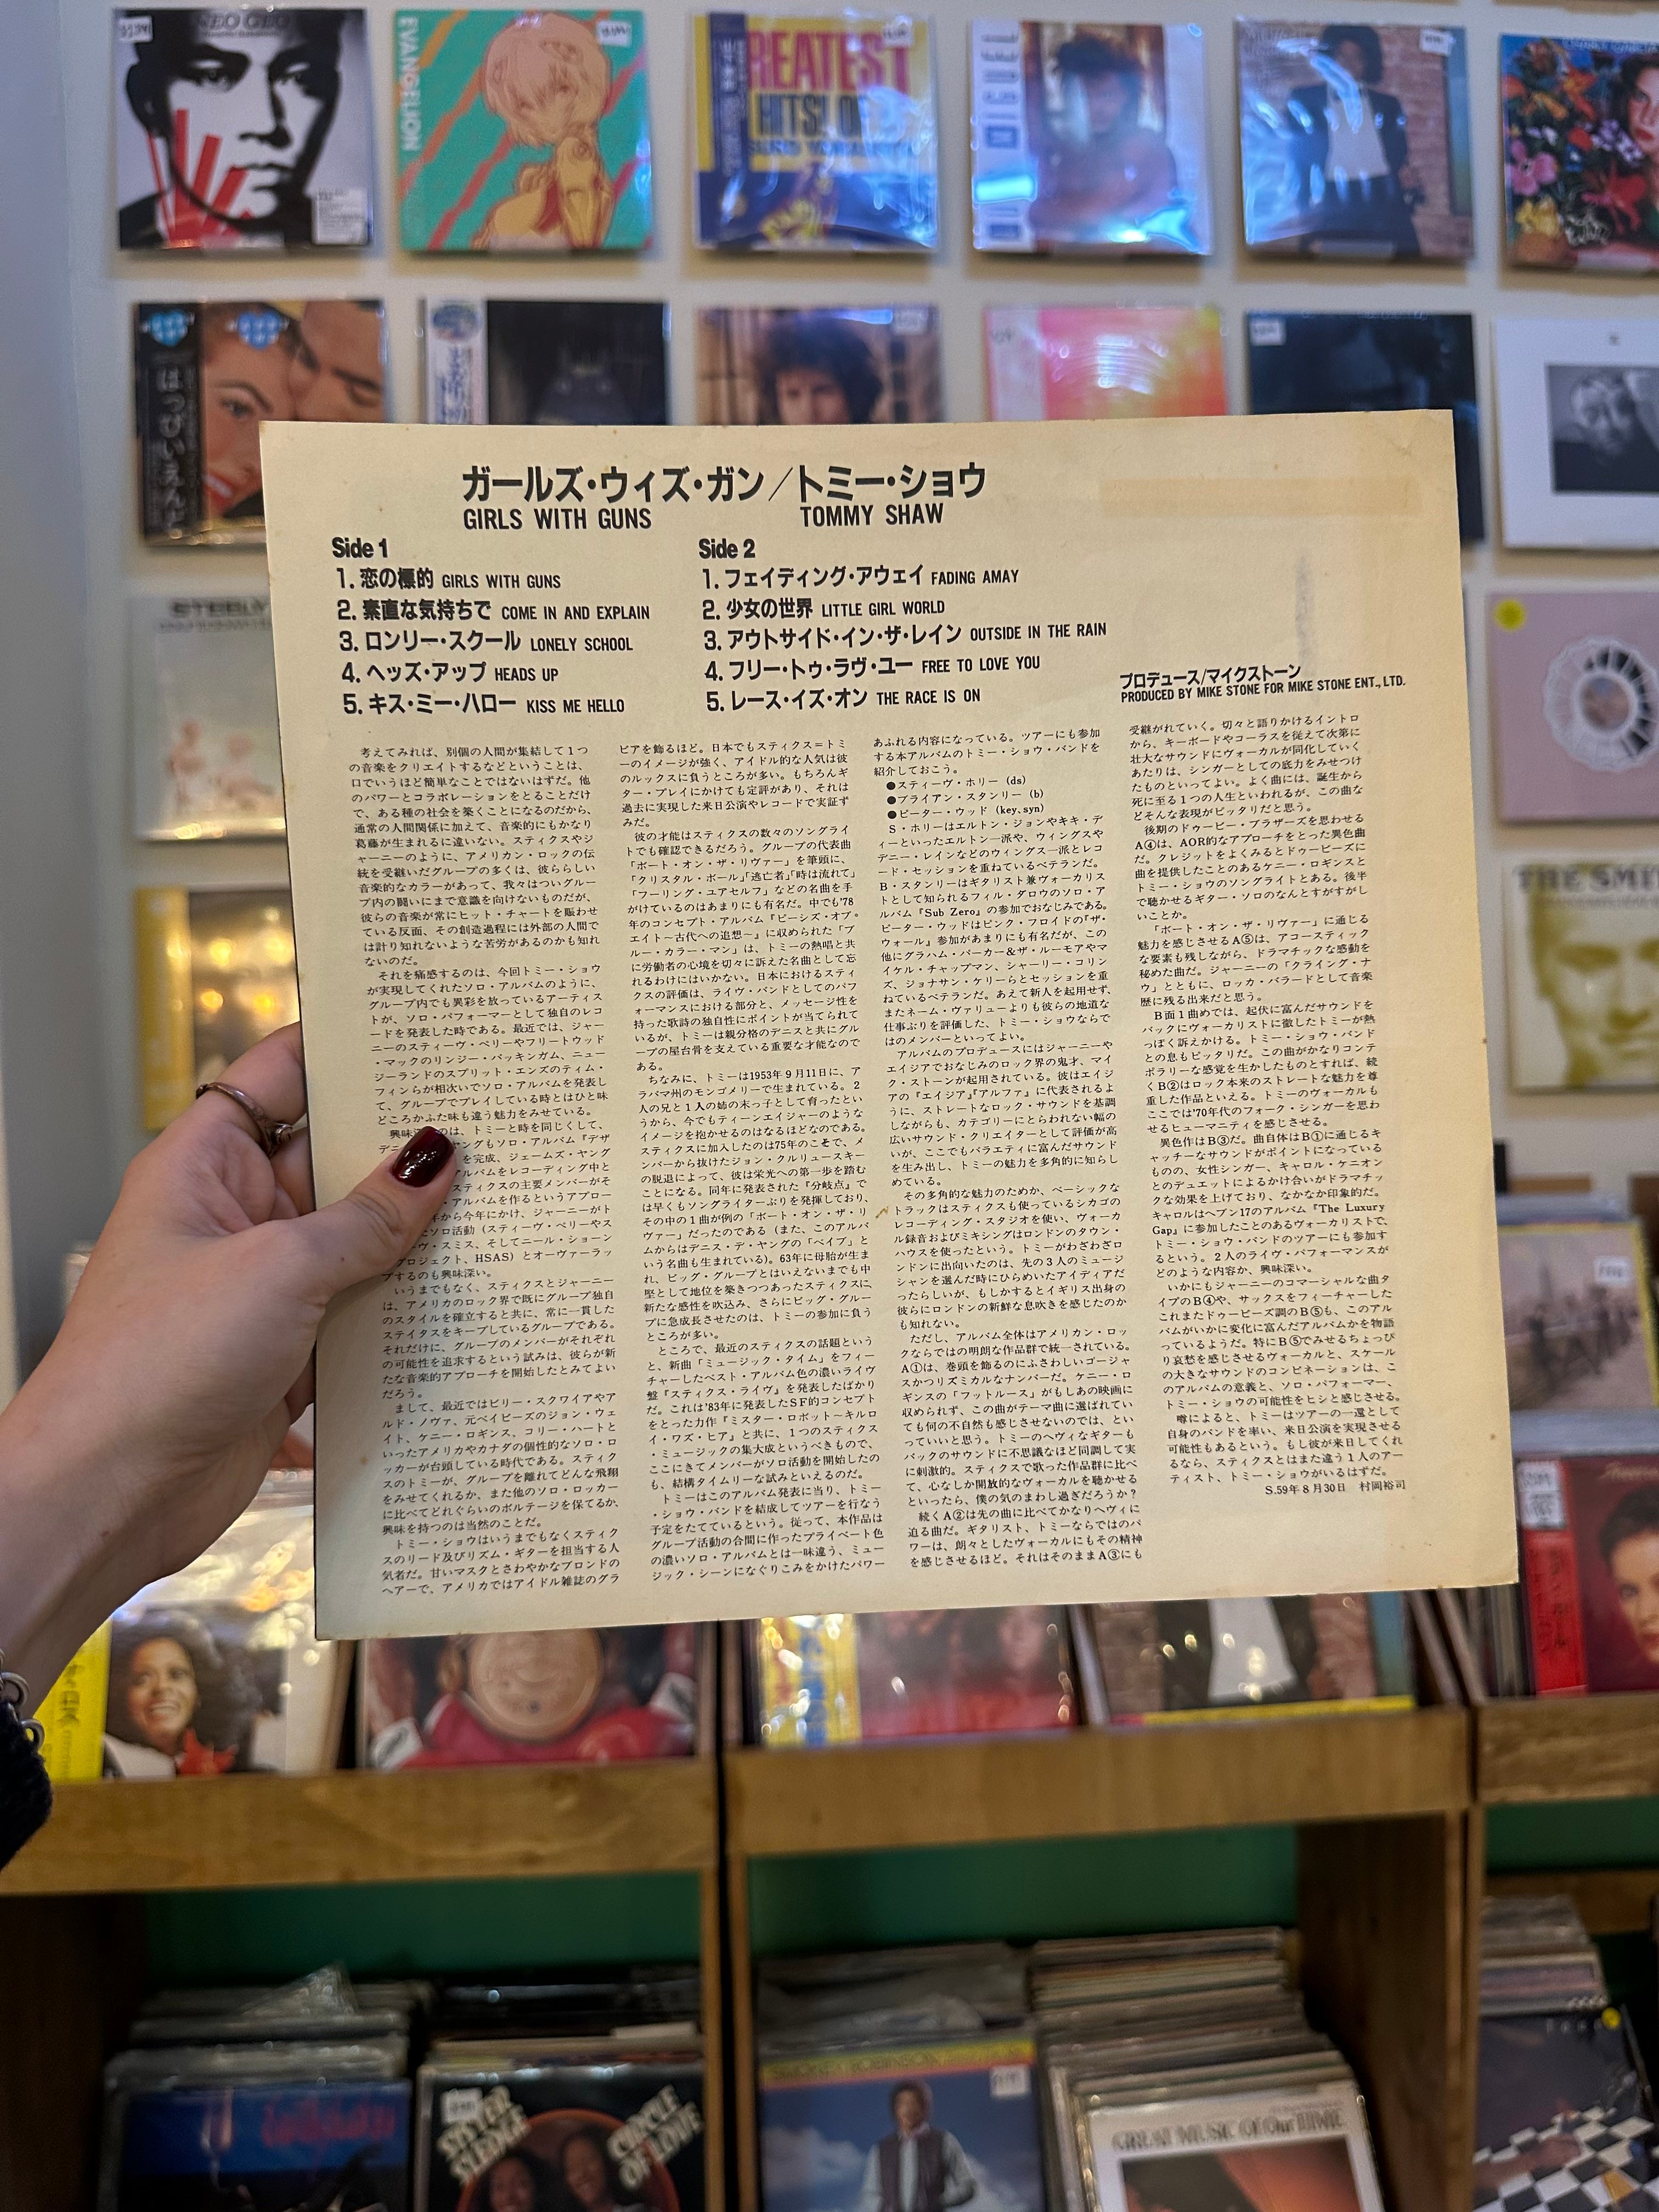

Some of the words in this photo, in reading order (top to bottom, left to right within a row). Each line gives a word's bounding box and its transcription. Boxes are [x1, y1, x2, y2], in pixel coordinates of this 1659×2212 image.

[399, 16, 421, 151] EVANGELION
[463, 508, 522, 529] GIRLS
[533, 508, 586, 529] WITH
[598, 507, 651, 529] GUNS
[799, 504, 873, 527] TOMMY
[885, 503, 943, 525] SHAW
[331, 537, 374, 558] Side
[378, 538, 387, 558] 1
[698, 538, 738, 559] Side
[743, 538, 755, 558] 2
[336, 567, 354, 589] 1.
[359, 567, 433, 589] 恋の標的
[442, 574, 478, 588] GIRLS
[486, 574, 520, 588] WITH
[527, 574, 561, 588] GUNS
[702, 568, 719, 589] 1.
[725, 563, 923, 589] フェイディング・アウェイ
[931, 571, 975, 585] FADING
[982, 569, 1019, 583] AMAY
[337, 599, 356, 620] 2.
[362, 598, 491, 620] 素直な気持ちで
[501, 606, 537, 619] COME
[543, 606, 557, 619] IN
[564, 606, 589, 619] AND
[596, 605, 650, 619] EXPLAIN
[702, 599, 720, 620] 2.
[726, 597, 812, 619] 少女の世界
[822, 602, 862, 617] LITTLE
[868, 602, 896, 616] GIRL
[902, 600, 944, 614] WORLD
[339, 630, 358, 652] 3.
[365, 629, 521, 651] ロンリー・スクール
[531, 637, 577, 651] LONELY
[584, 637, 633, 651] SCHOOL
[704, 630, 721, 651] 3.
[727, 624, 961, 650] アウトサイド・イン・ザ・レイン
[970, 626, 1021, 641] OUTSIDE
[1028, 625, 1040, 639] IN
[1047, 624, 1070, 637] THE
[1076, 622, 1106, 636] RAIN
[341, 662, 360, 683] 4.
[366, 661, 486, 682] ヘッズ・アップ
[494, 667, 535, 681] HEADS
[542, 668, 558, 681] UP
[704, 661, 723, 681] 4.
[729, 657, 912, 680] フリー・トゥ・ラヴ・ユー
[922, 659, 950, 673] FREE
[956, 658, 972, 672] TO
[979, 657, 1009, 671] LOVE
[1015, 655, 1040, 669] YOU
[706, 691, 724, 712] 5.
[731, 687, 867, 710] レース・イズ・オン
[876, 691, 899, 705] THE
[905, 690, 937, 704] RACE
[944, 689, 955, 703] IS
[963, 688, 980, 702] ON
[1121, 689, 1174, 703] PRODUCED
[1178, 687, 1192, 699] BY
[1197, 685, 1222, 698] MIKE
[1226, 683, 1260, 696] STONE
[1263, 682, 1283, 693] FOR
[1288, 680, 1313, 692] MIKE
[1317, 678, 1351, 691] STONE
[343, 693, 363, 714] 5.
[369, 692, 516, 715] キス・ミー・ハロー
[526, 699, 556, 713] KISS
[563, 699, 582, 713] ME
[587, 698, 624, 713] HELLO
[873, 763, 958, 777] 紹介しておこう。
[622, 817, 650, 828] みだ。
[1591, 865, 1659, 893] SMI
[1136, 910, 1187, 921] いことか。
[364, 955, 418, 967] ないのだ。
[636, 1061, 663, 1071] ある。
[891, 1176, 941, 1187] めている。
[899, 1318, 960, 1330] も知れない。
[646, 1329, 719, 1342] ところが多い。
[382, 1387, 422, 1400] だろう。
